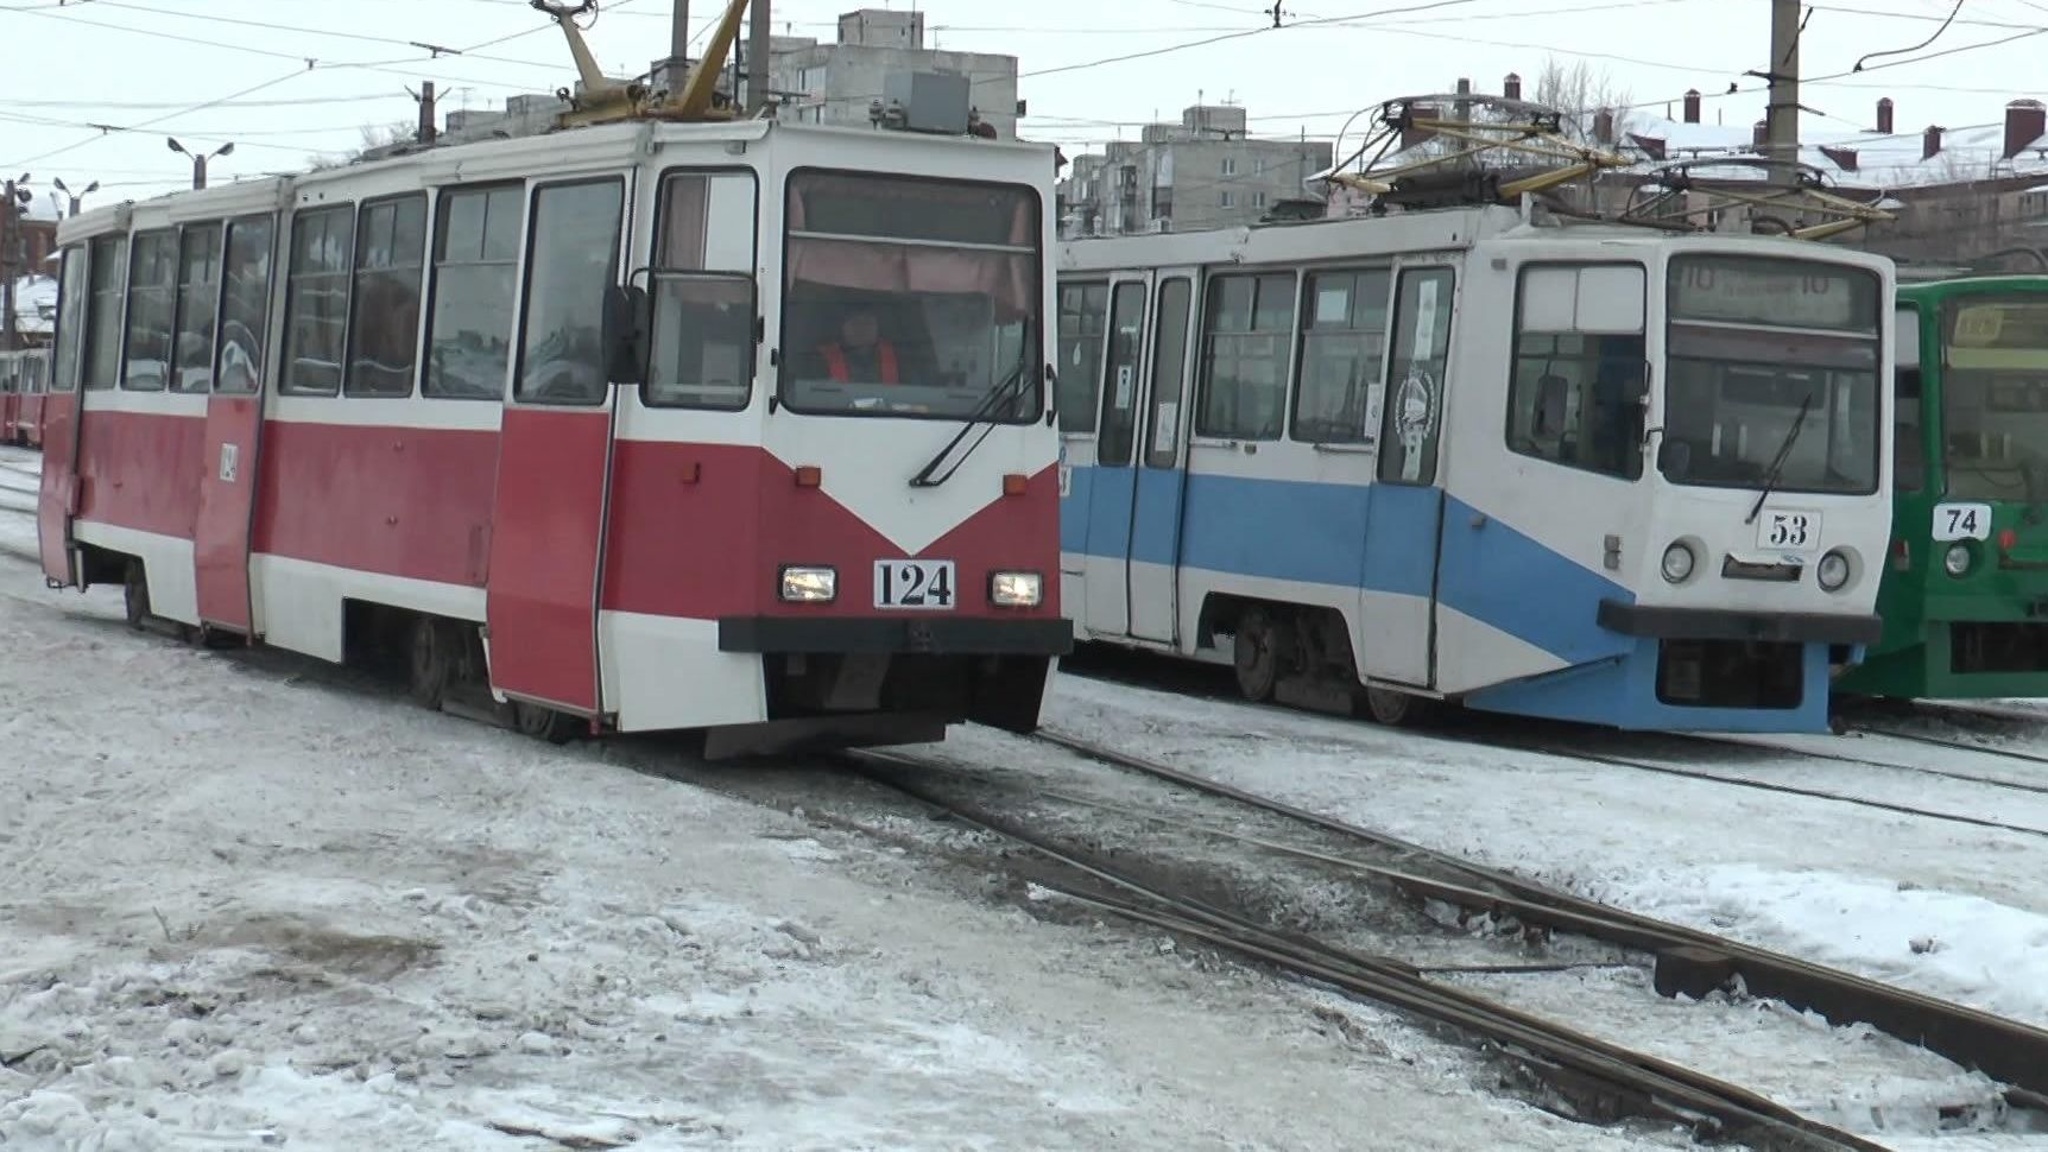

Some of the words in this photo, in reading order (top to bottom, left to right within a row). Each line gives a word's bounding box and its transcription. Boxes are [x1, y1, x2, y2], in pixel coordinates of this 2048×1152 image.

[1770, 514, 1807, 546] 53
[1946, 509, 1977, 534] 74
[879, 563, 952, 605] 124
